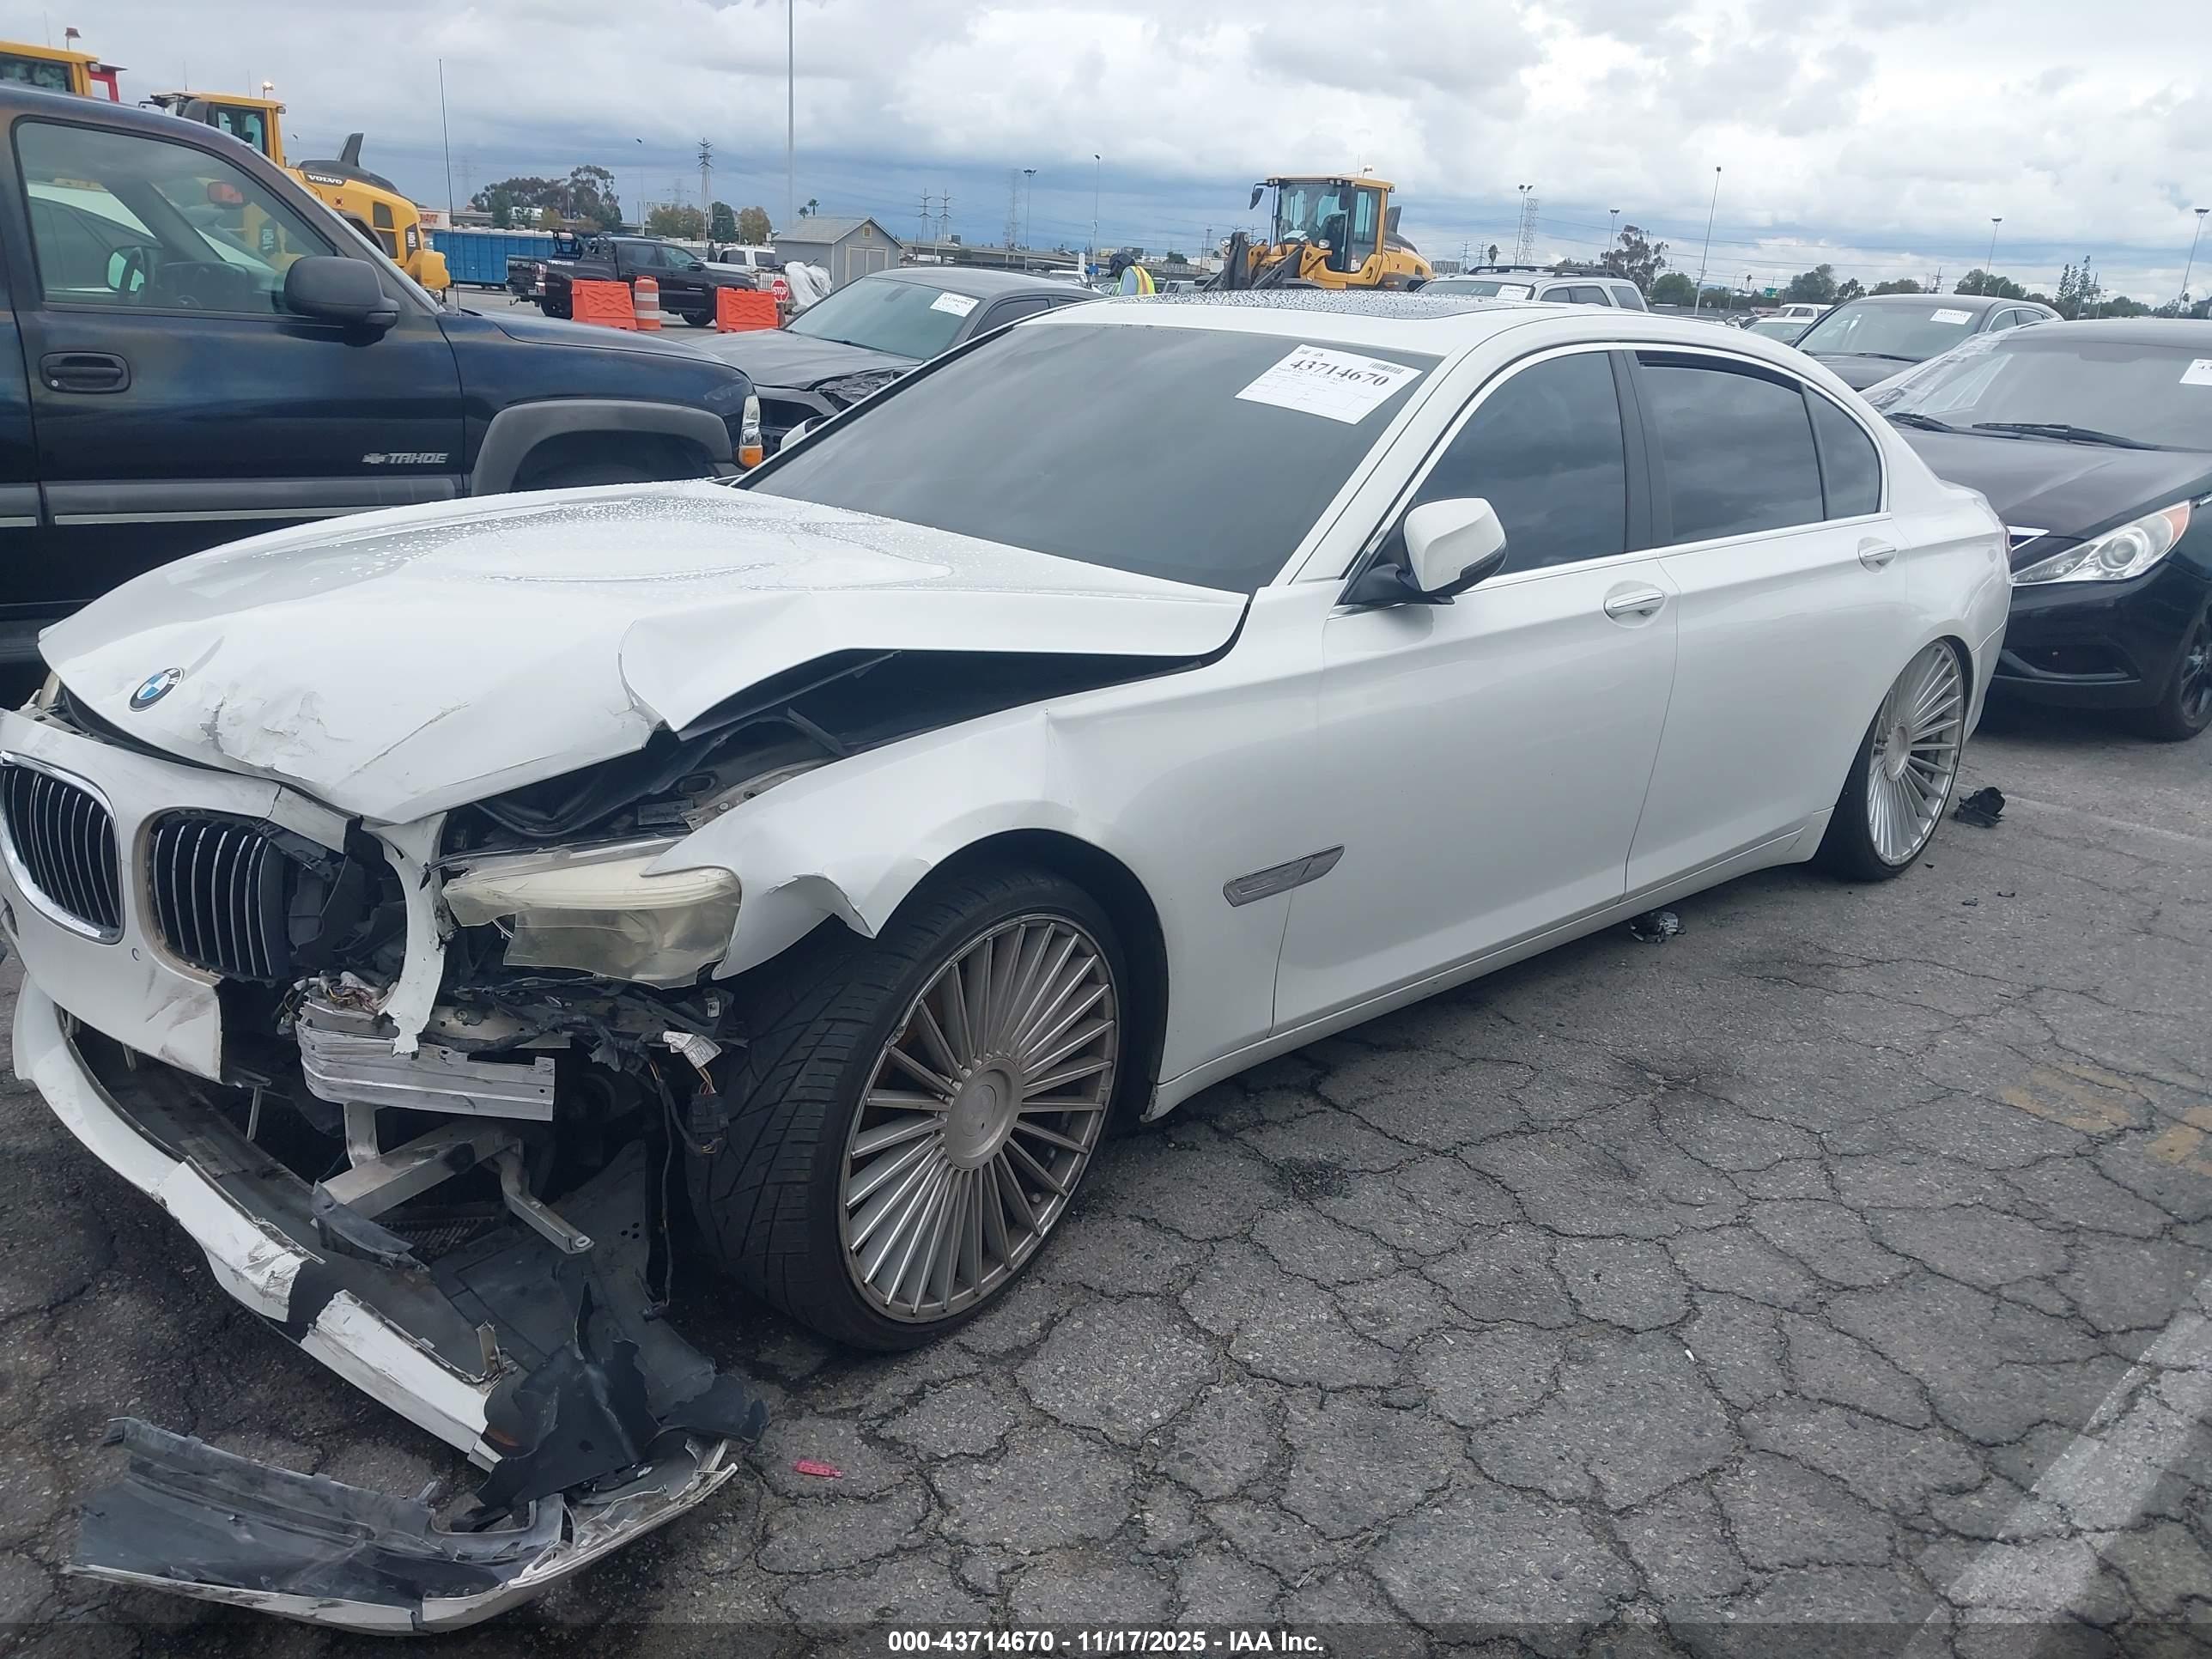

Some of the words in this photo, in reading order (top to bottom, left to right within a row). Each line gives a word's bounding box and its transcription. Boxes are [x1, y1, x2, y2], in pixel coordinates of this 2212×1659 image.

[307, 174, 343, 185] VOLVO
[773, 286, 787, 295] STOP
[1290, 359, 1389, 386] 43714670
[388, 453, 449, 464] TAHOE
